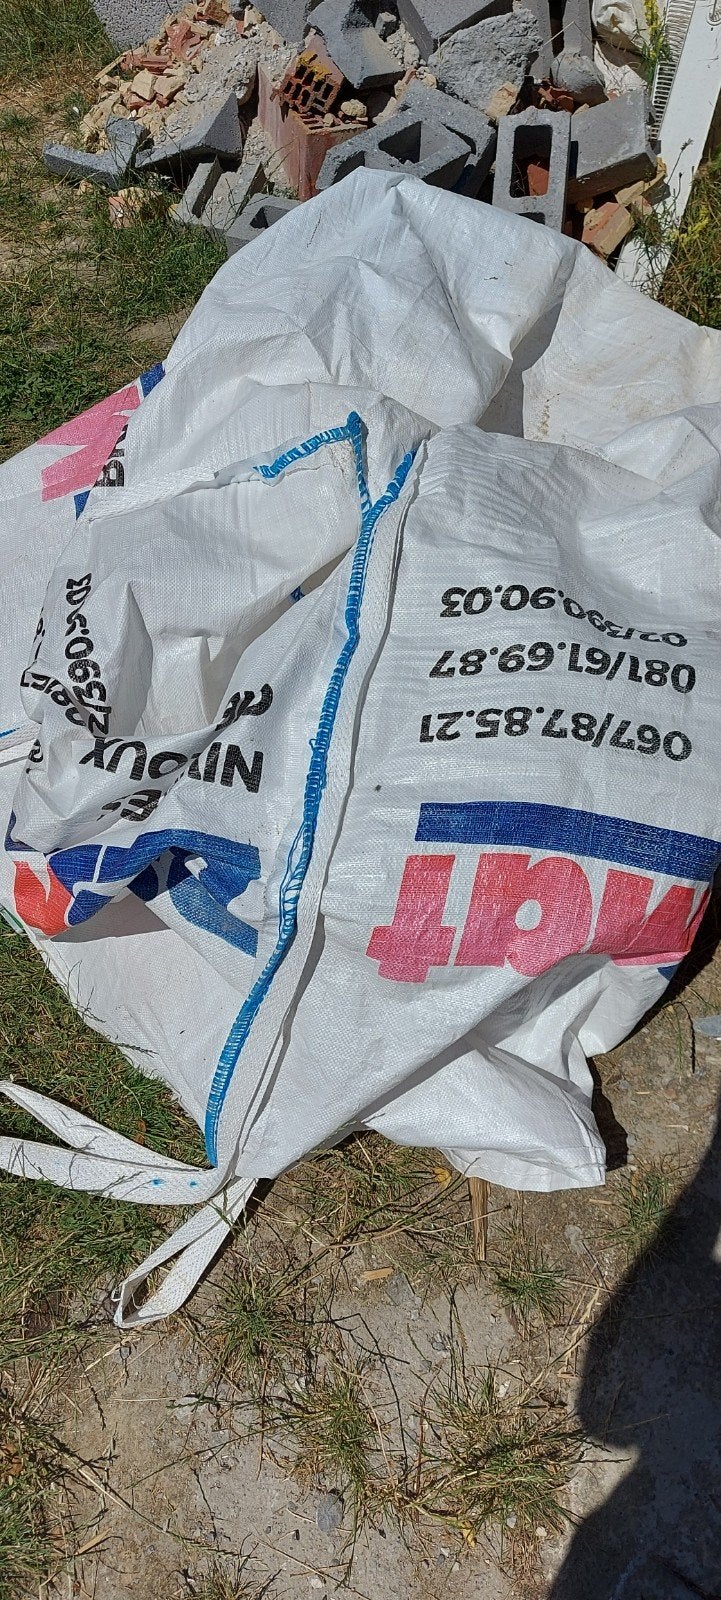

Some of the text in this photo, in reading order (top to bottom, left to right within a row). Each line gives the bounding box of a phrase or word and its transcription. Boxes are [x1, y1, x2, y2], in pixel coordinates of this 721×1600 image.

[439, 584, 688, 648] 02/390.90.03
[429, 641, 696, 693] 081/61.69.87
[419, 706, 692, 761] 067/87.85.21
